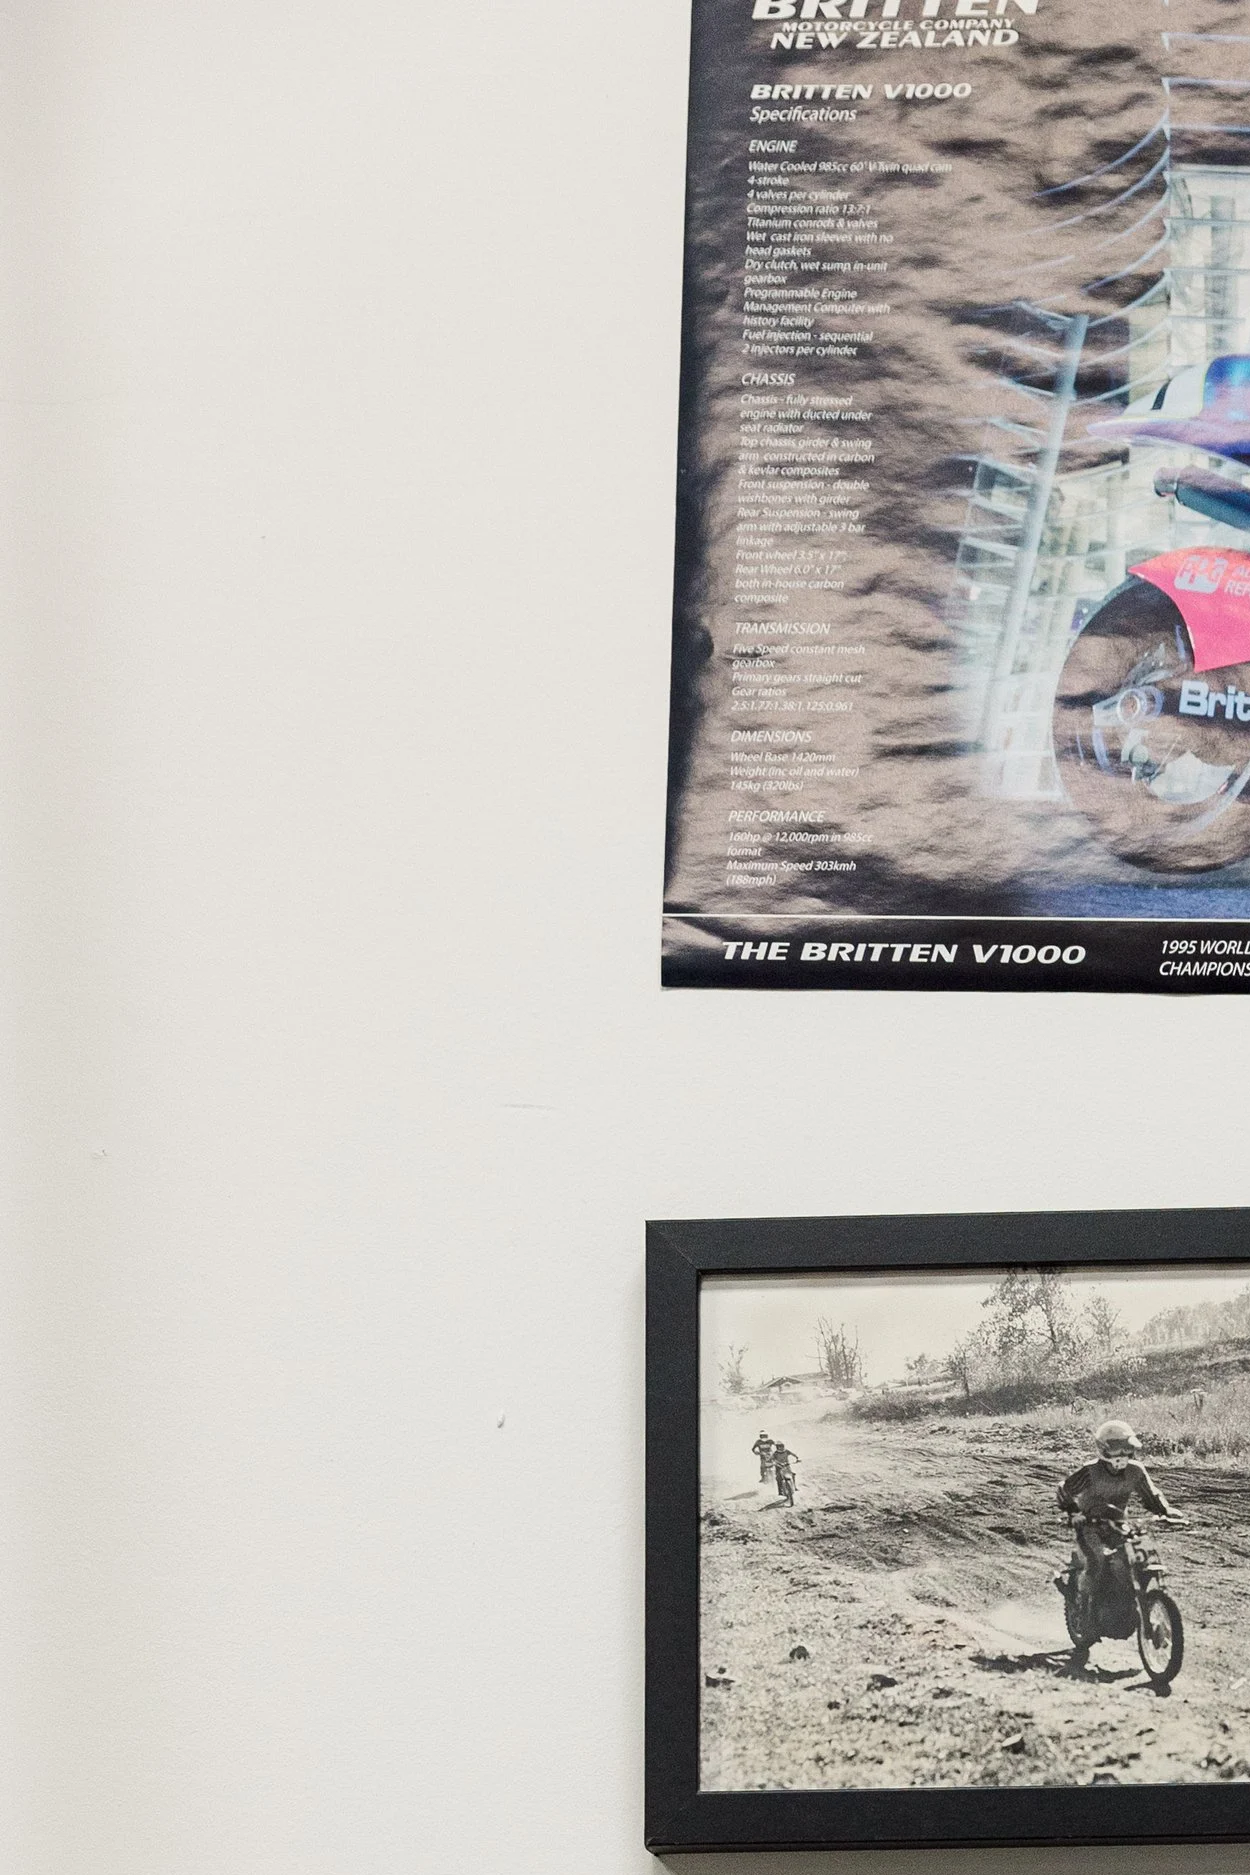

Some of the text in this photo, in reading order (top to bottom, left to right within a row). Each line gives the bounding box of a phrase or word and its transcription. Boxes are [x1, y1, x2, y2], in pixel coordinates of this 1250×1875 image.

[782, 18, 1014, 32] MOTORCYCLE COMPANY
[770, 30, 1020, 49] NEW ZEALAND
[750, 83, 972, 99] BRITTEN V1000
[750, 106, 857, 123] Specifications
[748, 140, 797, 153] ENGINE
[748, 161, 926, 175] Water Cooled 985cc quad
[747, 175, 789, 186] 4-stroke
[755, 189, 851, 204] valves cylinder
[746, 203, 839, 217] Compression ratio
[747, 217, 878, 229] Titanium conrods valves
[746, 232, 877, 243] Wet cast iron sleeves with
[745, 245, 812, 258] head gaskets
[745, 259, 888, 271] Dry wet in-unit
[744, 274, 787, 285] gearbox
[744, 288, 857, 300] Programmable Engine
[744, 302, 890, 315] Management Computer with
[743, 315, 815, 328] history facility
[743, 330, 873, 344] Fuel injection sequential
[750, 344, 857, 356] injectors per cylinder
[742, 373, 796, 385] CHASSIS
[741, 394, 776, 405] Chassis
[740, 409, 872, 420] engine with ducted under
[739, 423, 804, 433] seat radiator
[740, 437, 872, 450] Top girder swing
[764, 451, 875, 463] constructed carbon
[747, 465, 840, 478] kevlar composites
[738, 480, 869, 492] Front suspension double
[738, 494, 851, 505] wishbones with girder
[737, 508, 860, 520] Rear Suspension swing
[757, 522, 866, 534] with adjustable bar
[736, 536, 774, 548] linkage
[736, 550, 763, 561] Front
[736, 565, 792, 576] Rear Wheel
[735, 579, 844, 590] both in-house carbon
[735, 593, 789, 606] composite
[735, 622, 830, 635] TRANSMISSION
[733, 645, 865, 656] Five Speed constant mesh
[732, 659, 775, 670] gearbox
[732, 673, 862, 685] Primary gears straight cut
[732, 687, 787, 697] Gear ratios
[731, 730, 812, 743] DIMENSIONS
[730, 752, 835, 763] Wheel Base 1420mm
[730, 766, 859, 778] Weight and water)
[730, 780, 803, 792] 145kg (320lbs)
[728, 810, 825, 822] PERFORMANCE
[729, 832, 873, 844] 160hp 12,000rpm 985cc
[727, 846, 761, 858] format
[727, 860, 856, 872] Maximum Speed 303kmh
[726, 875, 776, 886] (188mph)
[723, 941, 1086, 964] THE BRITTEN V1000
[1161, 940, 1196, 954] 1995
